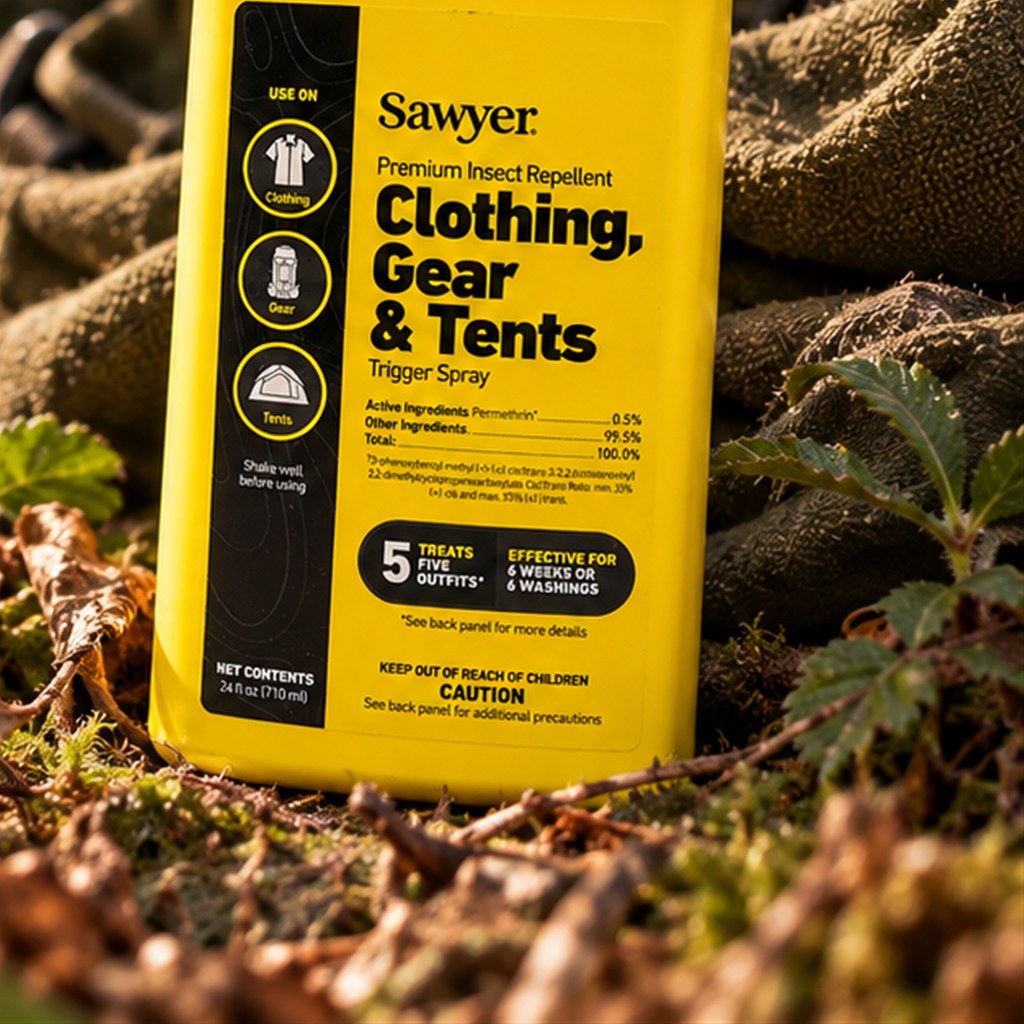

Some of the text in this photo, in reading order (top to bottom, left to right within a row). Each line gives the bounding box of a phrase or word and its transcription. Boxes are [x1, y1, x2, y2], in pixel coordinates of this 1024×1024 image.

[269, 86, 318, 102] USE ON
[377, 156, 613, 189] Premium Insect Repellent
[265, 191, 311, 208] Clothing
[376, 184, 644, 261] Clothing,
[372, 242, 520, 300] Gear
[370, 299, 597, 363] & Tents
[368, 358, 491, 389] Trigger Spray
[366, 399, 401, 413] Active
[404, 402, 469, 417] Ingredients
[612, 413, 642, 426] 0.5%
[365, 416, 642, 444] Other Ingredients 99.5%
[364, 432, 641, 461] Total: 100.0%
[276, 480, 307, 495] using
[382, 540, 411, 584] 5
[418, 543, 474, 559] TREATS
[508, 548, 617, 566] EFFECTIVE FOR
[418, 558, 450, 572] FIVE
[507, 564, 596, 581] 6 WEEKS OR
[507, 579, 599, 596] 6 WASHINGS
[430, 616, 457, 631] back
[460, 619, 492, 634] panel
[495, 621, 512, 634] for
[514, 625, 546, 637] more
[548, 624, 588, 638] details
[216, 661, 315, 686] NET CONTENTS
[379, 661, 589, 687] KEEP OUT OF REACH OF CHILDREN
[219, 679, 233, 694] 24
[261, 684, 286, 701] (710
[439, 683, 525, 705] CAUTION
[364, 696, 602, 726] See back panel for additional precautions
